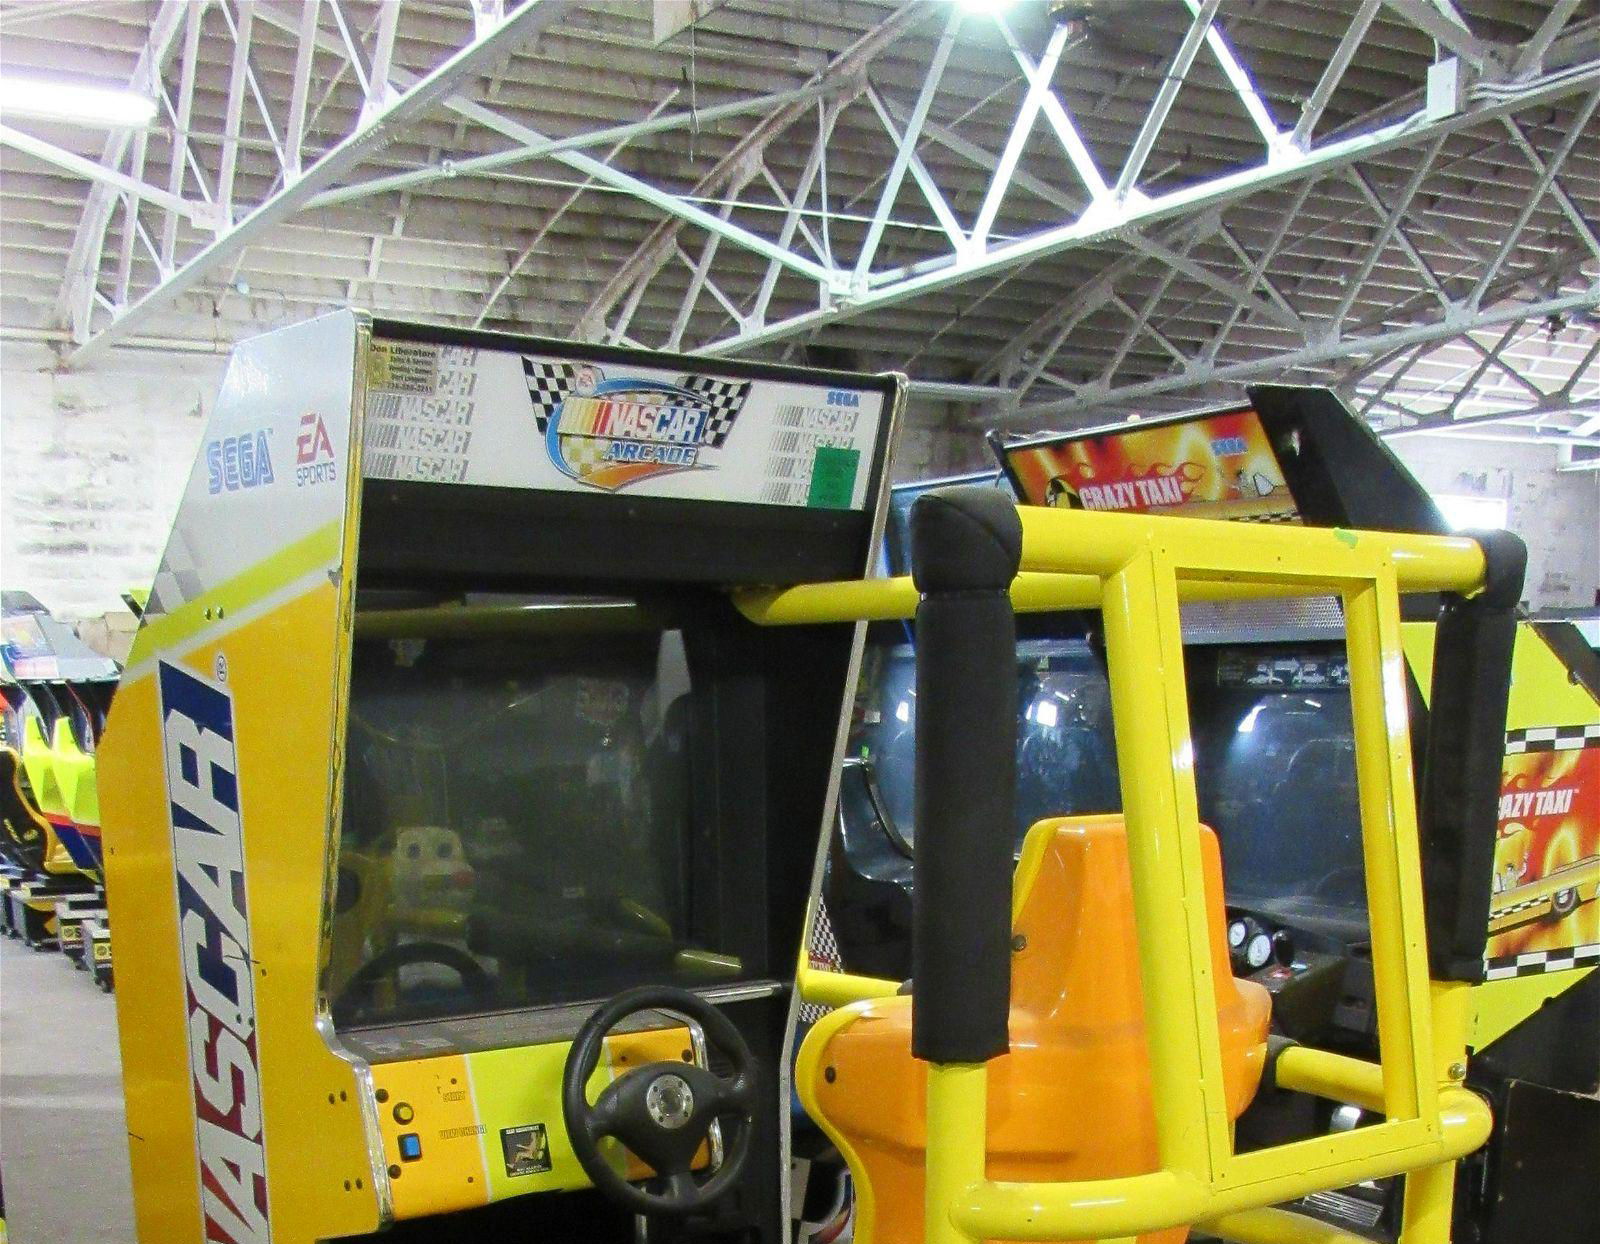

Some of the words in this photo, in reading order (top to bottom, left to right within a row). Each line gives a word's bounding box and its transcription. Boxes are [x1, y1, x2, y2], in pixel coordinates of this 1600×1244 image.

[370, 343, 388, 353] Don
[400, 396, 475, 427] NASCAR
[826, 391, 860, 407] SEGA
[604, 399, 709, 445] NASCAR
[296, 414, 335, 465] EA
[398, 424, 473, 455] NASCAR
[603, 440, 698, 466] ARCADE
[206, 429, 275, 495] SEGA
[296, 461, 337, 487] SPORTS
[394, 453, 470, 481] NASCAR
[1079, 481, 1138, 511] CRAZY
[1136, 475, 1183, 505] TAXI
[1498, 793, 1535, 820] AZY
[1535, 788, 1573, 816] TAXI
